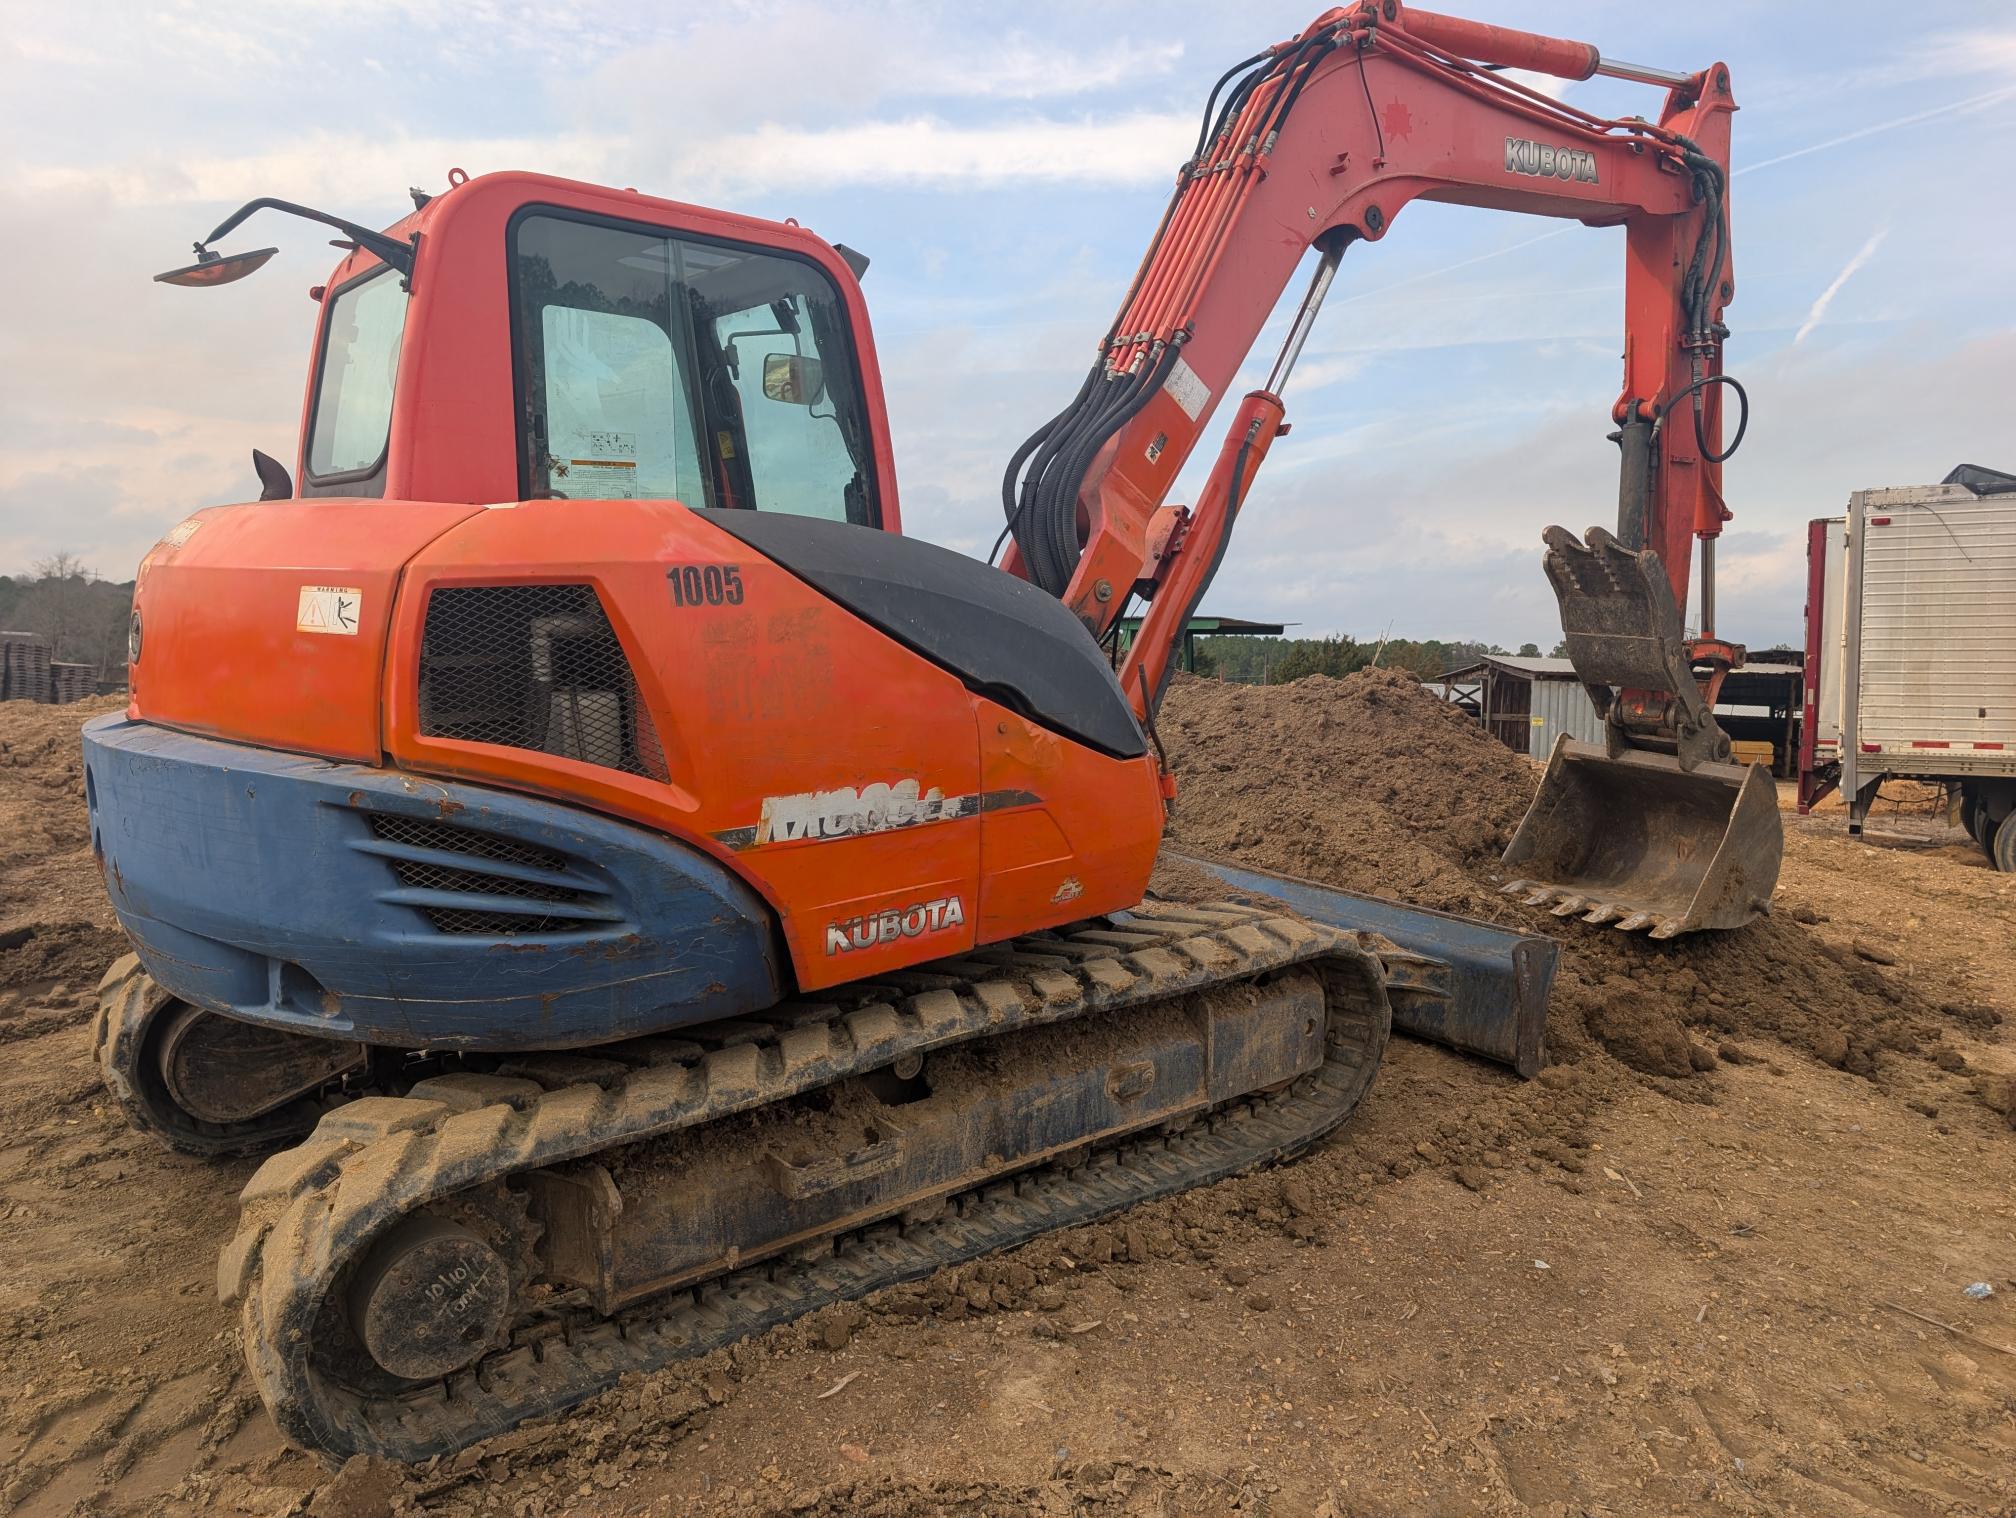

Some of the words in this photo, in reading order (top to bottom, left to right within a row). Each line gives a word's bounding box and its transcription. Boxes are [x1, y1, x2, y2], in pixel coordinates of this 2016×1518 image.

[1505, 138, 1599, 185] KUBOTA
[667, 565, 744, 607] 1005
[826, 896, 965, 956] KUBOTA
